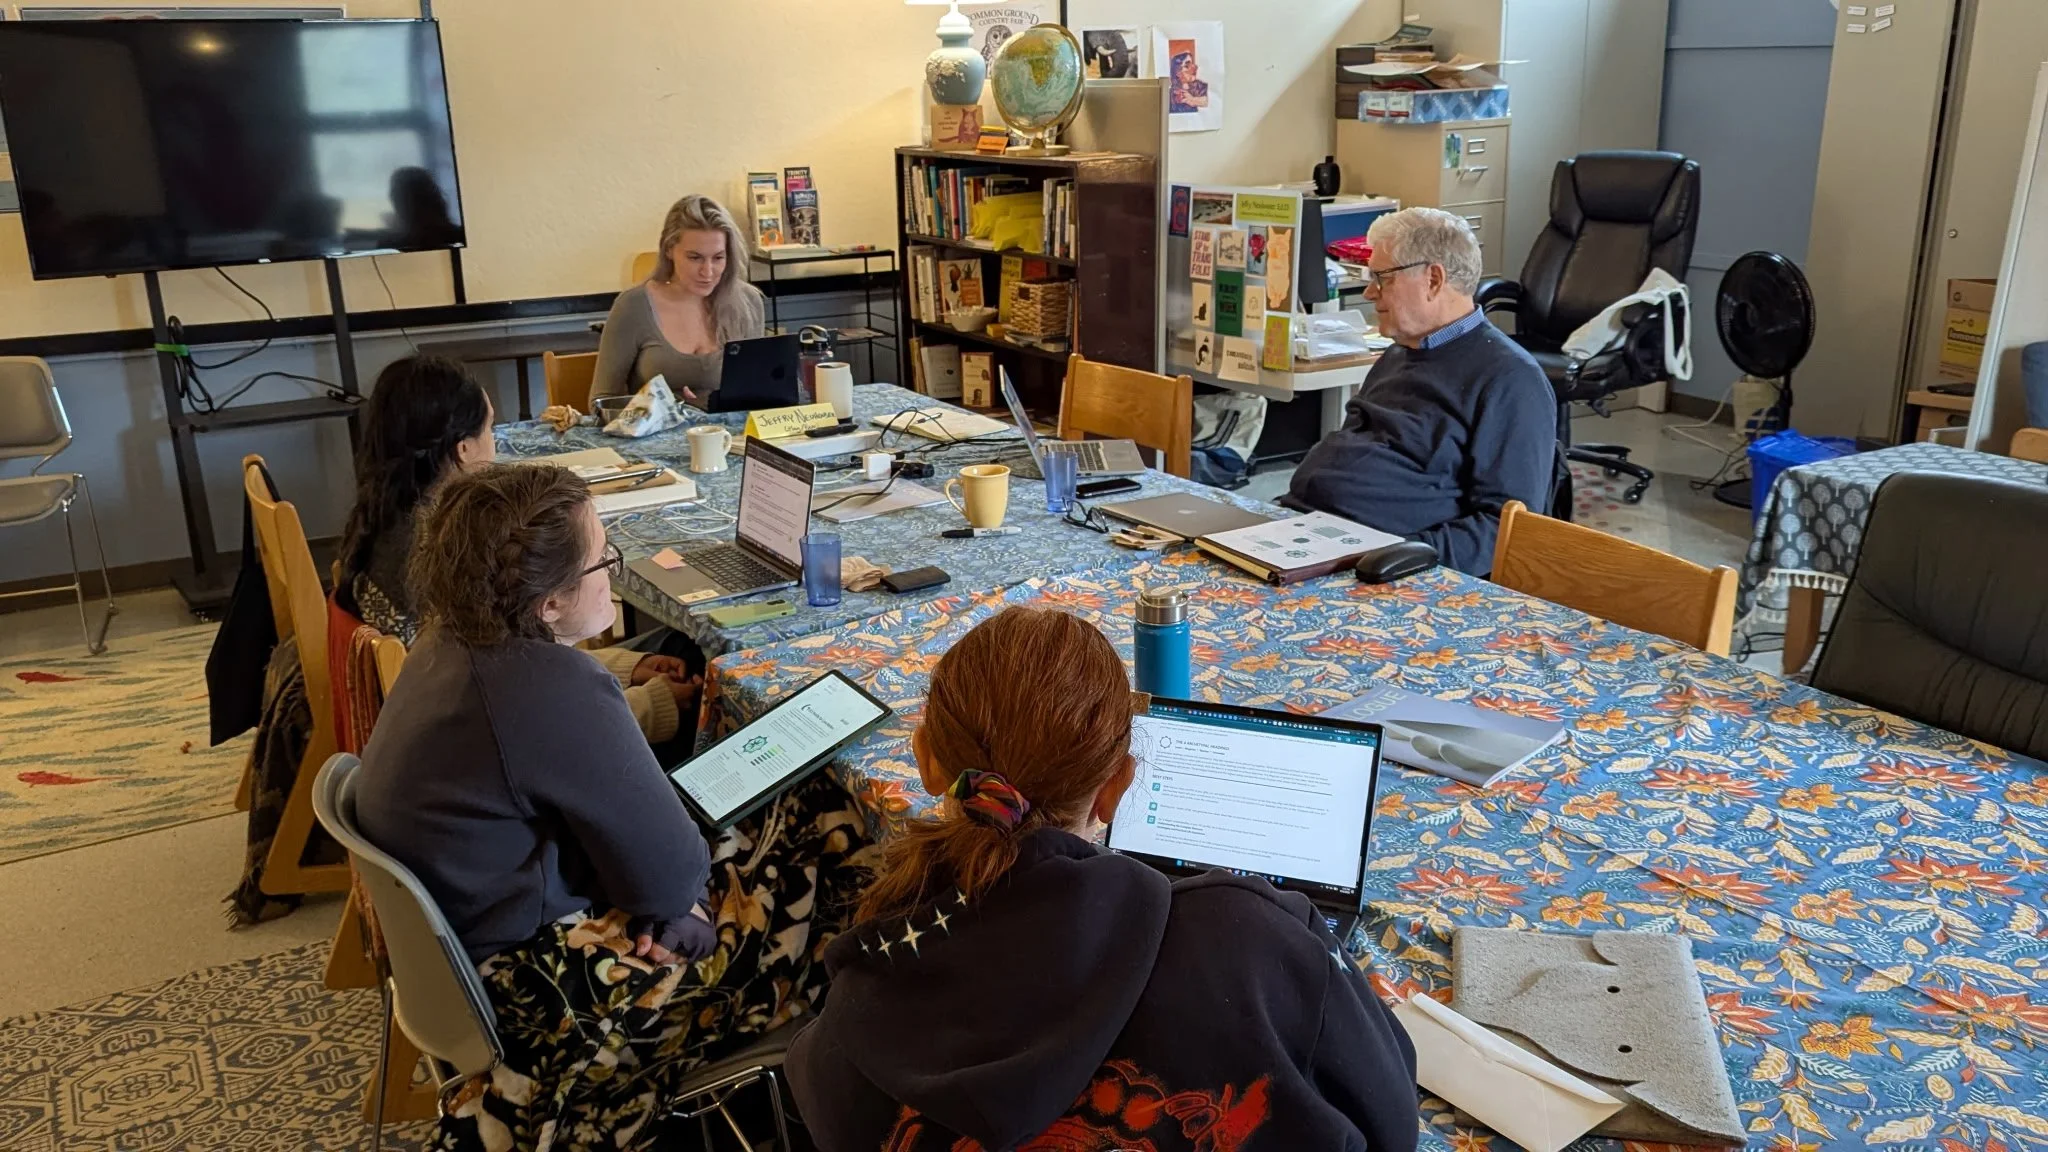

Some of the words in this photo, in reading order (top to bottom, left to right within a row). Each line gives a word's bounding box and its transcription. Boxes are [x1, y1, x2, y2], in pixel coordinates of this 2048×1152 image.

[968, 9, 1003, 22] OMMON
[1004, 9, 1039, 25] GROUND
[979, 17, 1008, 26] COUNTRY
[1193, 251, 1212, 264] TRANS
[758, 413, 794, 427] JEFFRY
